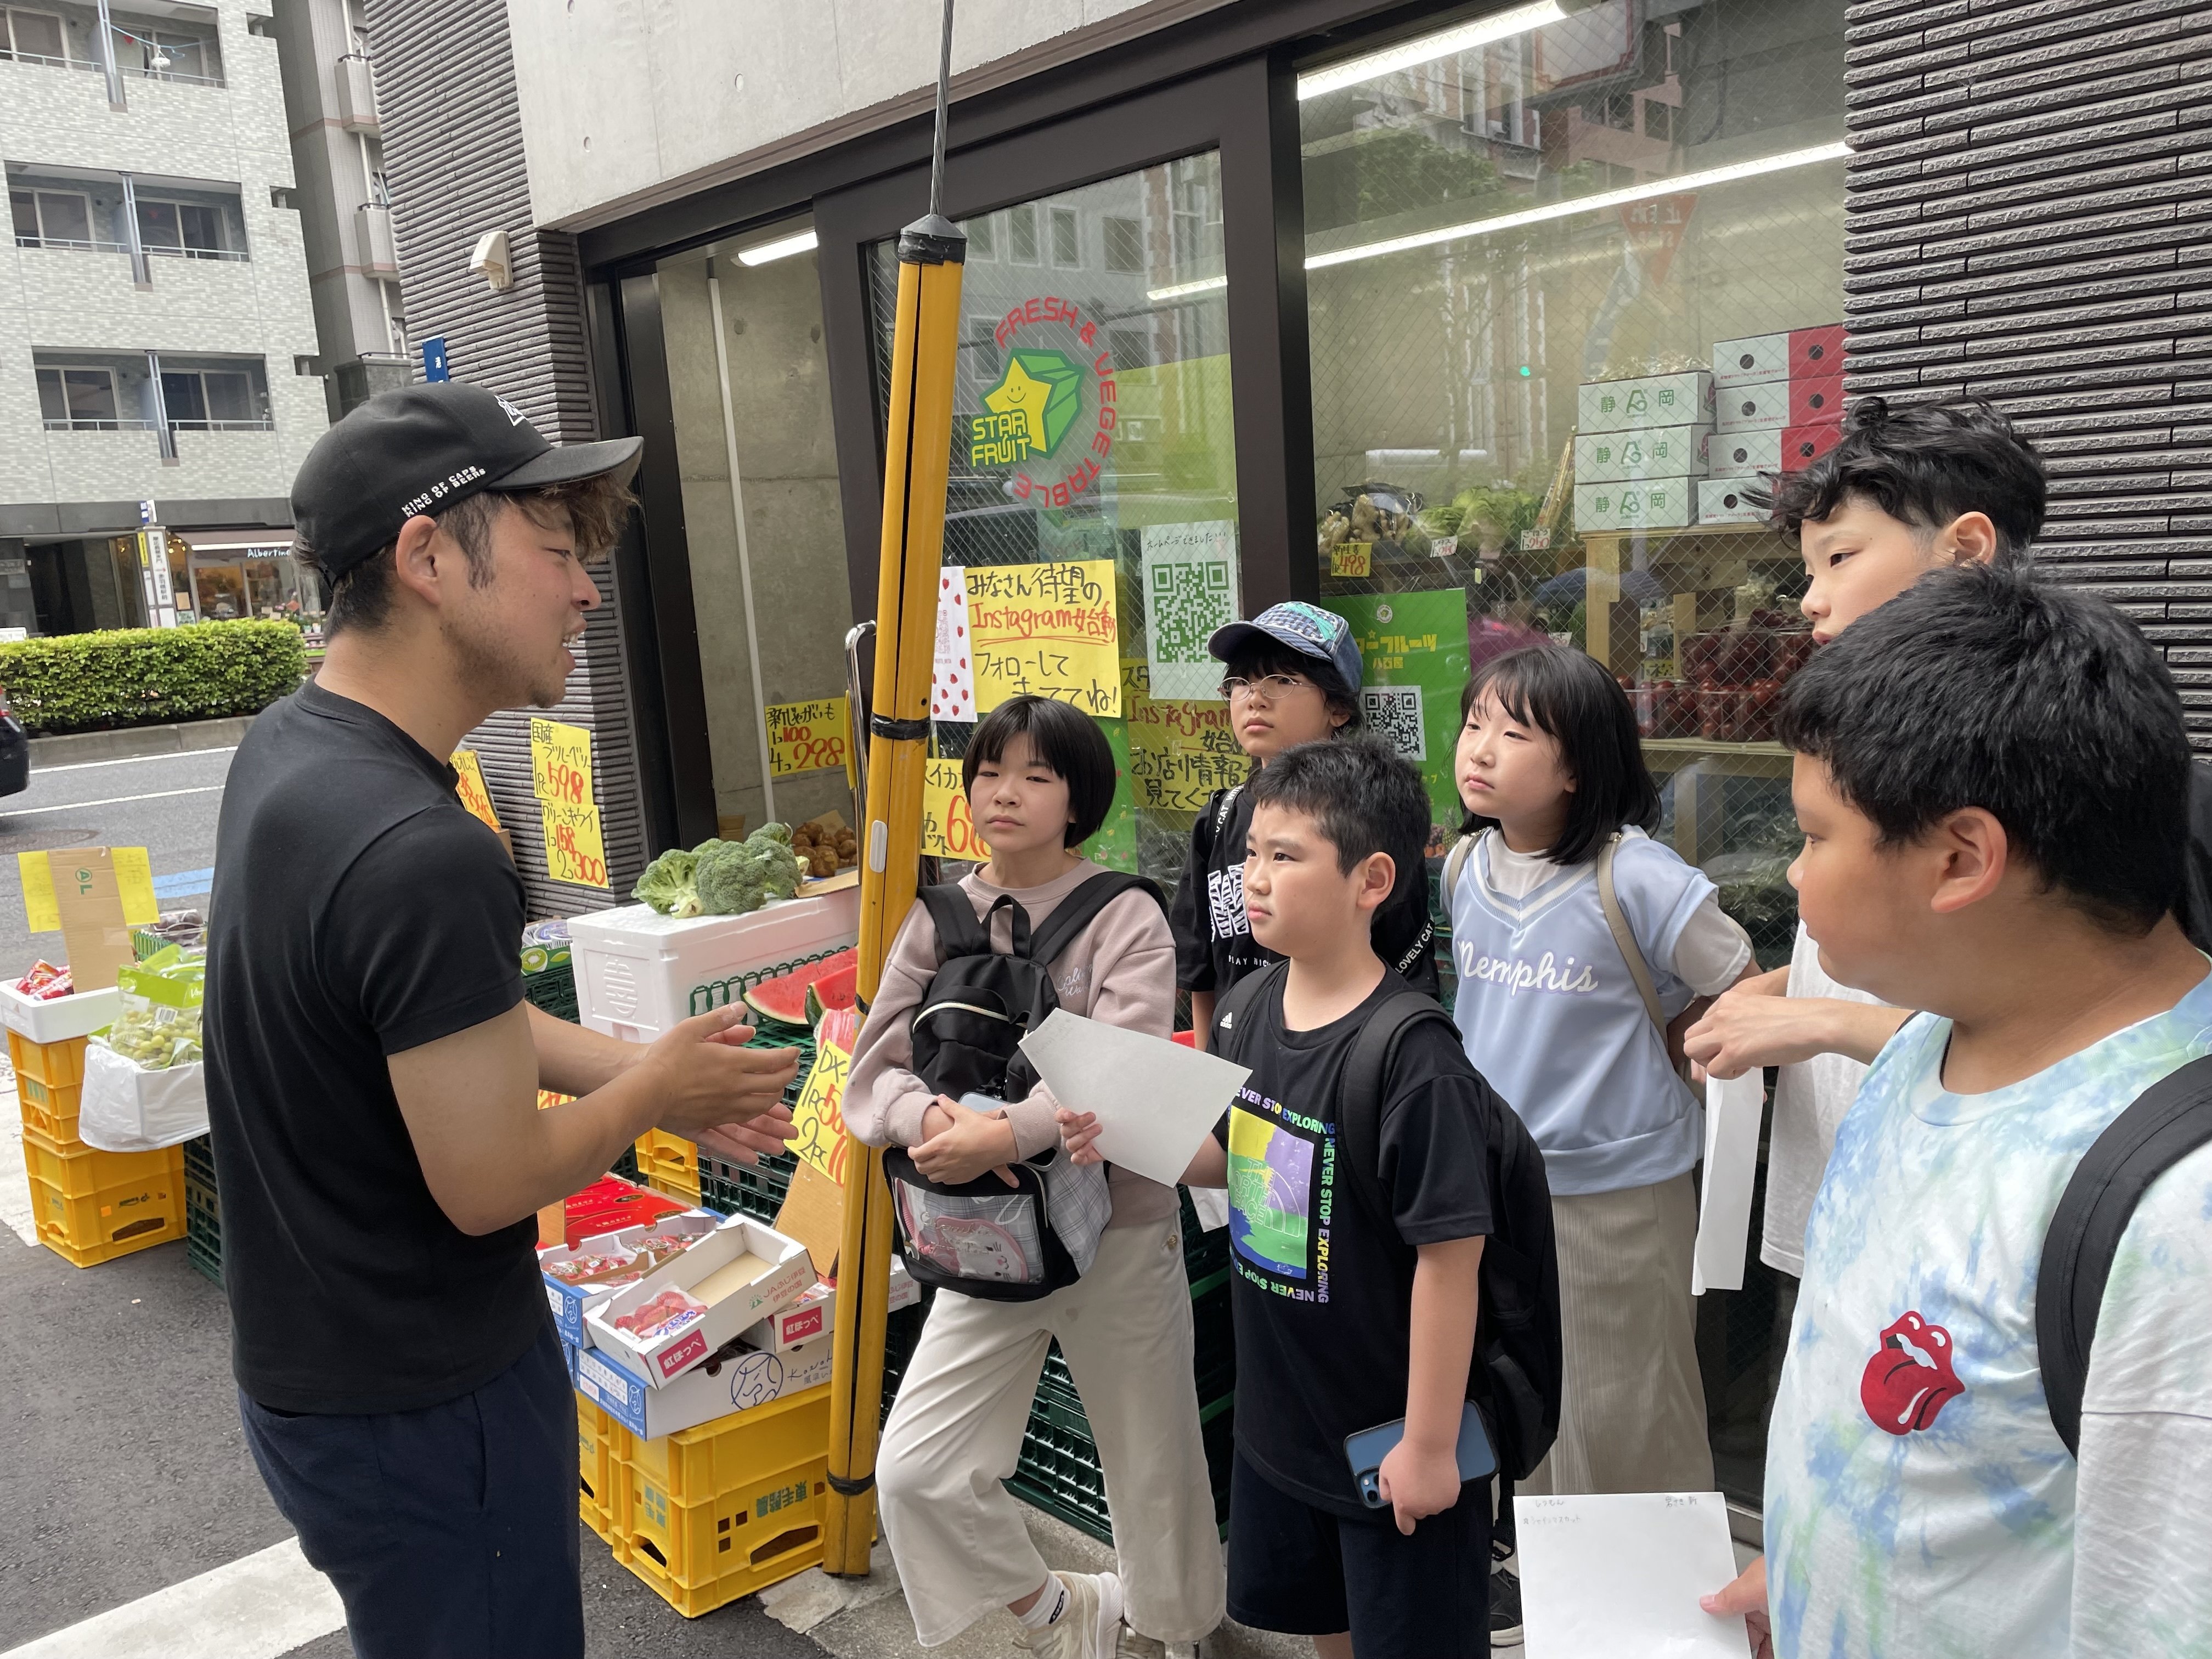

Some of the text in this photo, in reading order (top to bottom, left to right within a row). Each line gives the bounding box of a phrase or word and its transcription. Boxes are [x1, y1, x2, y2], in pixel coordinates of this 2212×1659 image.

[995, 296, 1079, 349] FRESH
[1080, 321, 1097, 348] &
[1601, 390, 1674, 413] 静 岡
[972, 411, 1027, 441] STAR
[1014, 351, 1117, 509] VEGETABLE
[972, 433, 1030, 467] FRUIT
[1596, 442, 1668, 463] 静 岡
[401, 466, 477, 513] KING OF CAPS
[405, 469, 486, 517] KING OF BEERS
[1595, 493, 1666, 513] 静 岡
[967, 563, 1102, 606] みなさん待望の
[975, 651, 1069, 680] フォローして
[766, 703, 835, 729] 新じゃがいも
[532, 721, 554, 744] 国産
[1254, 956, 1271, 967] NIC
[1395, 923, 1433, 974] LOVELY CAT
[1220, 1021, 1232, 1029] adidas
[1283, 1108, 1335, 1135] EXPLORING
[1228, 1164, 1273, 1207] NORTH
[1248, 1158, 1276, 1188] THE
[1236, 1189, 1266, 1225] FACE
[1317, 1138, 1335, 1303] NEVER STOP EXPLORING
[1245, 1269, 1314, 1302] NEVER STOP
[786, 1315, 819, 1335] 紅ほっぺ
[663, 1339, 702, 1370] 紅ほっぺ
